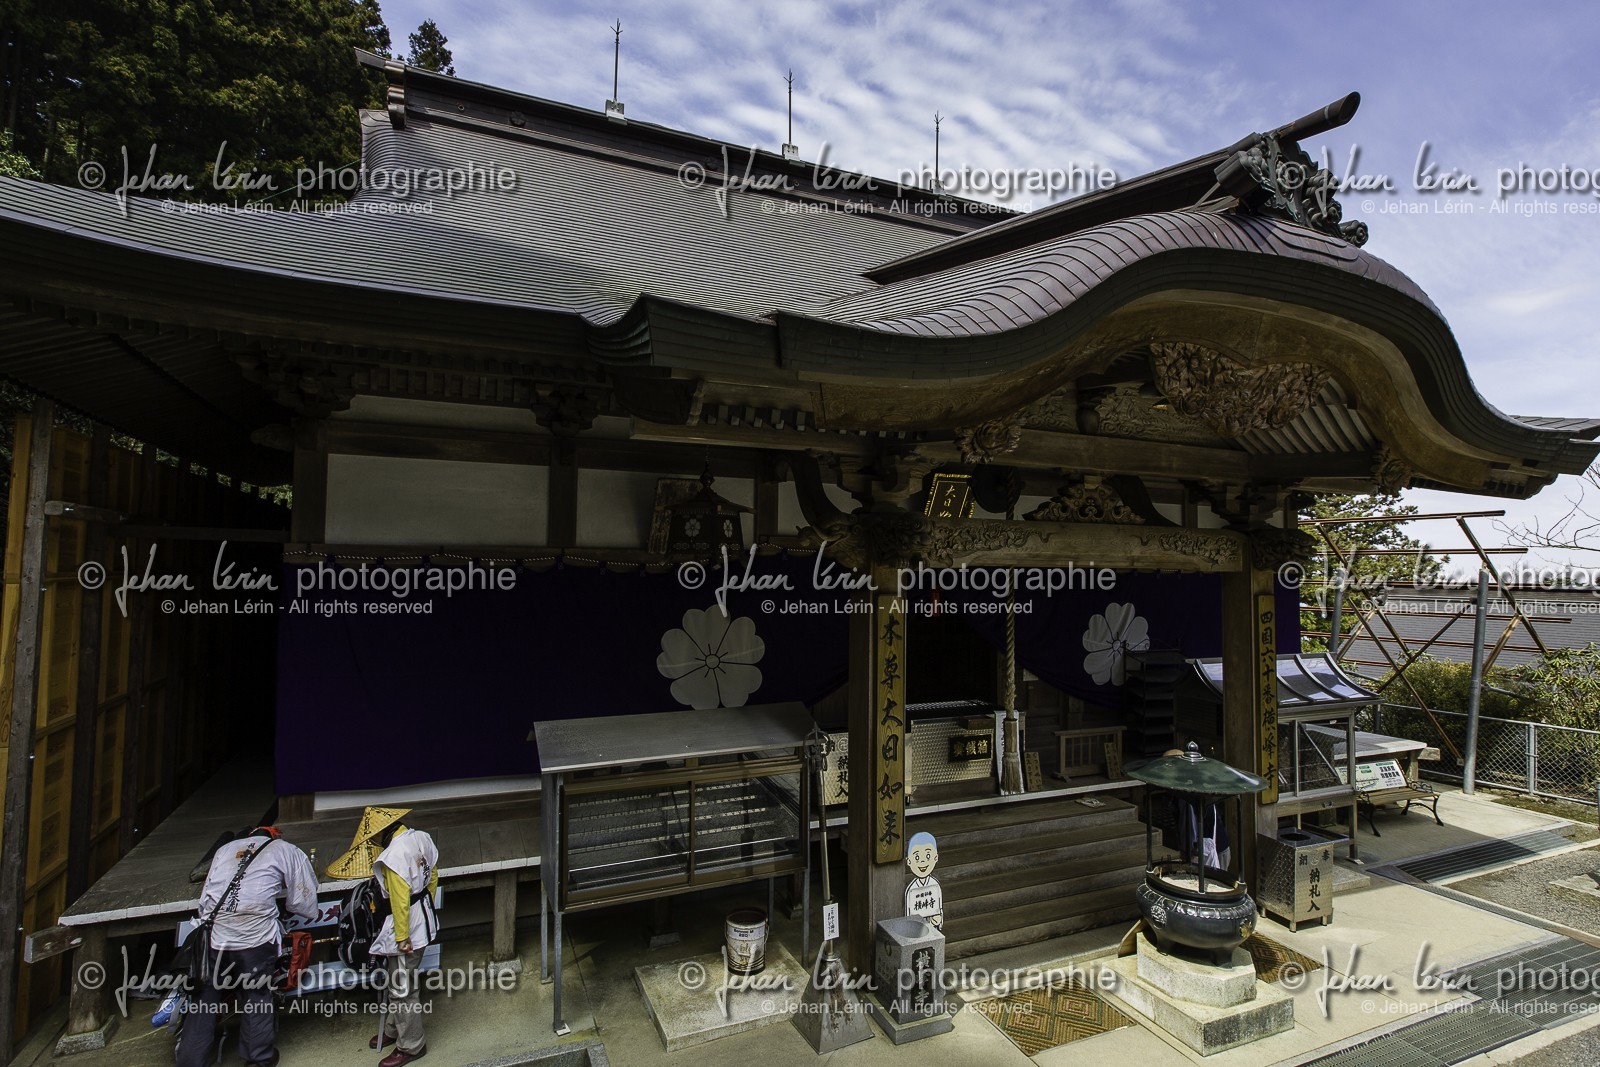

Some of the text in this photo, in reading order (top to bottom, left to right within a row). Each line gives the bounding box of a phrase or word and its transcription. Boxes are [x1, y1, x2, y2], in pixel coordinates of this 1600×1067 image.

[878, 614, 903, 846] 本尊大日如来
[1307, 867, 1321, 913] 納札入
